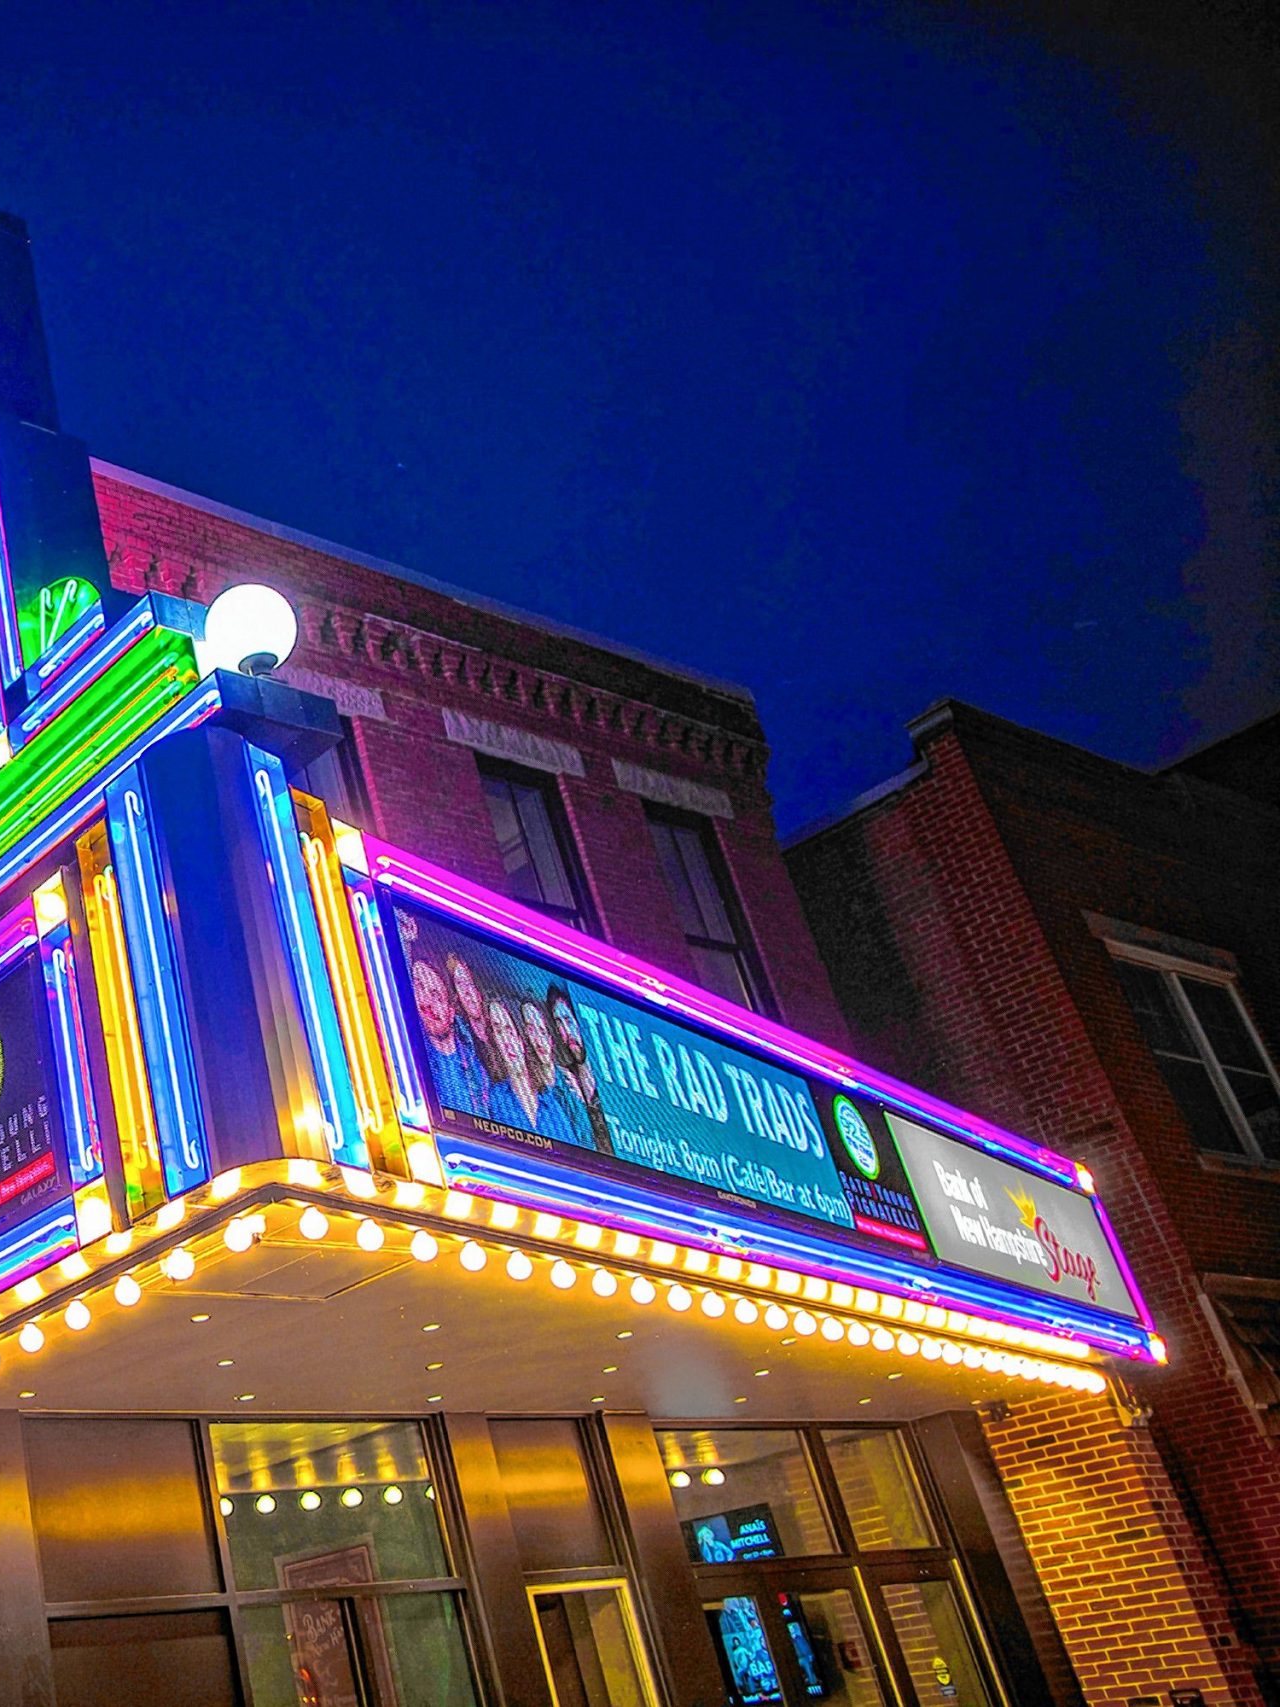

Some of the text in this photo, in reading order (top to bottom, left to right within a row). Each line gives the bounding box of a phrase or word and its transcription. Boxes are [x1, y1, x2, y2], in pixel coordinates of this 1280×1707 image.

[578, 1003, 825, 1160] THE RAD TRADS
[473, 1118, 553, 1150] NEOPCO.COM
[604, 1113, 682, 1172] Tonight
[679, 1138, 721, 1184] 8pm
[798, 1183, 818, 1210] at
[814, 1183, 856, 1230] 6pm)
[932, 1160, 989, 1211] Bank of
[949, 1204, 988, 1247] New
[978, 1213, 1049, 1268] Hampshire
[1034, 1216, 1102, 1303] Stage
